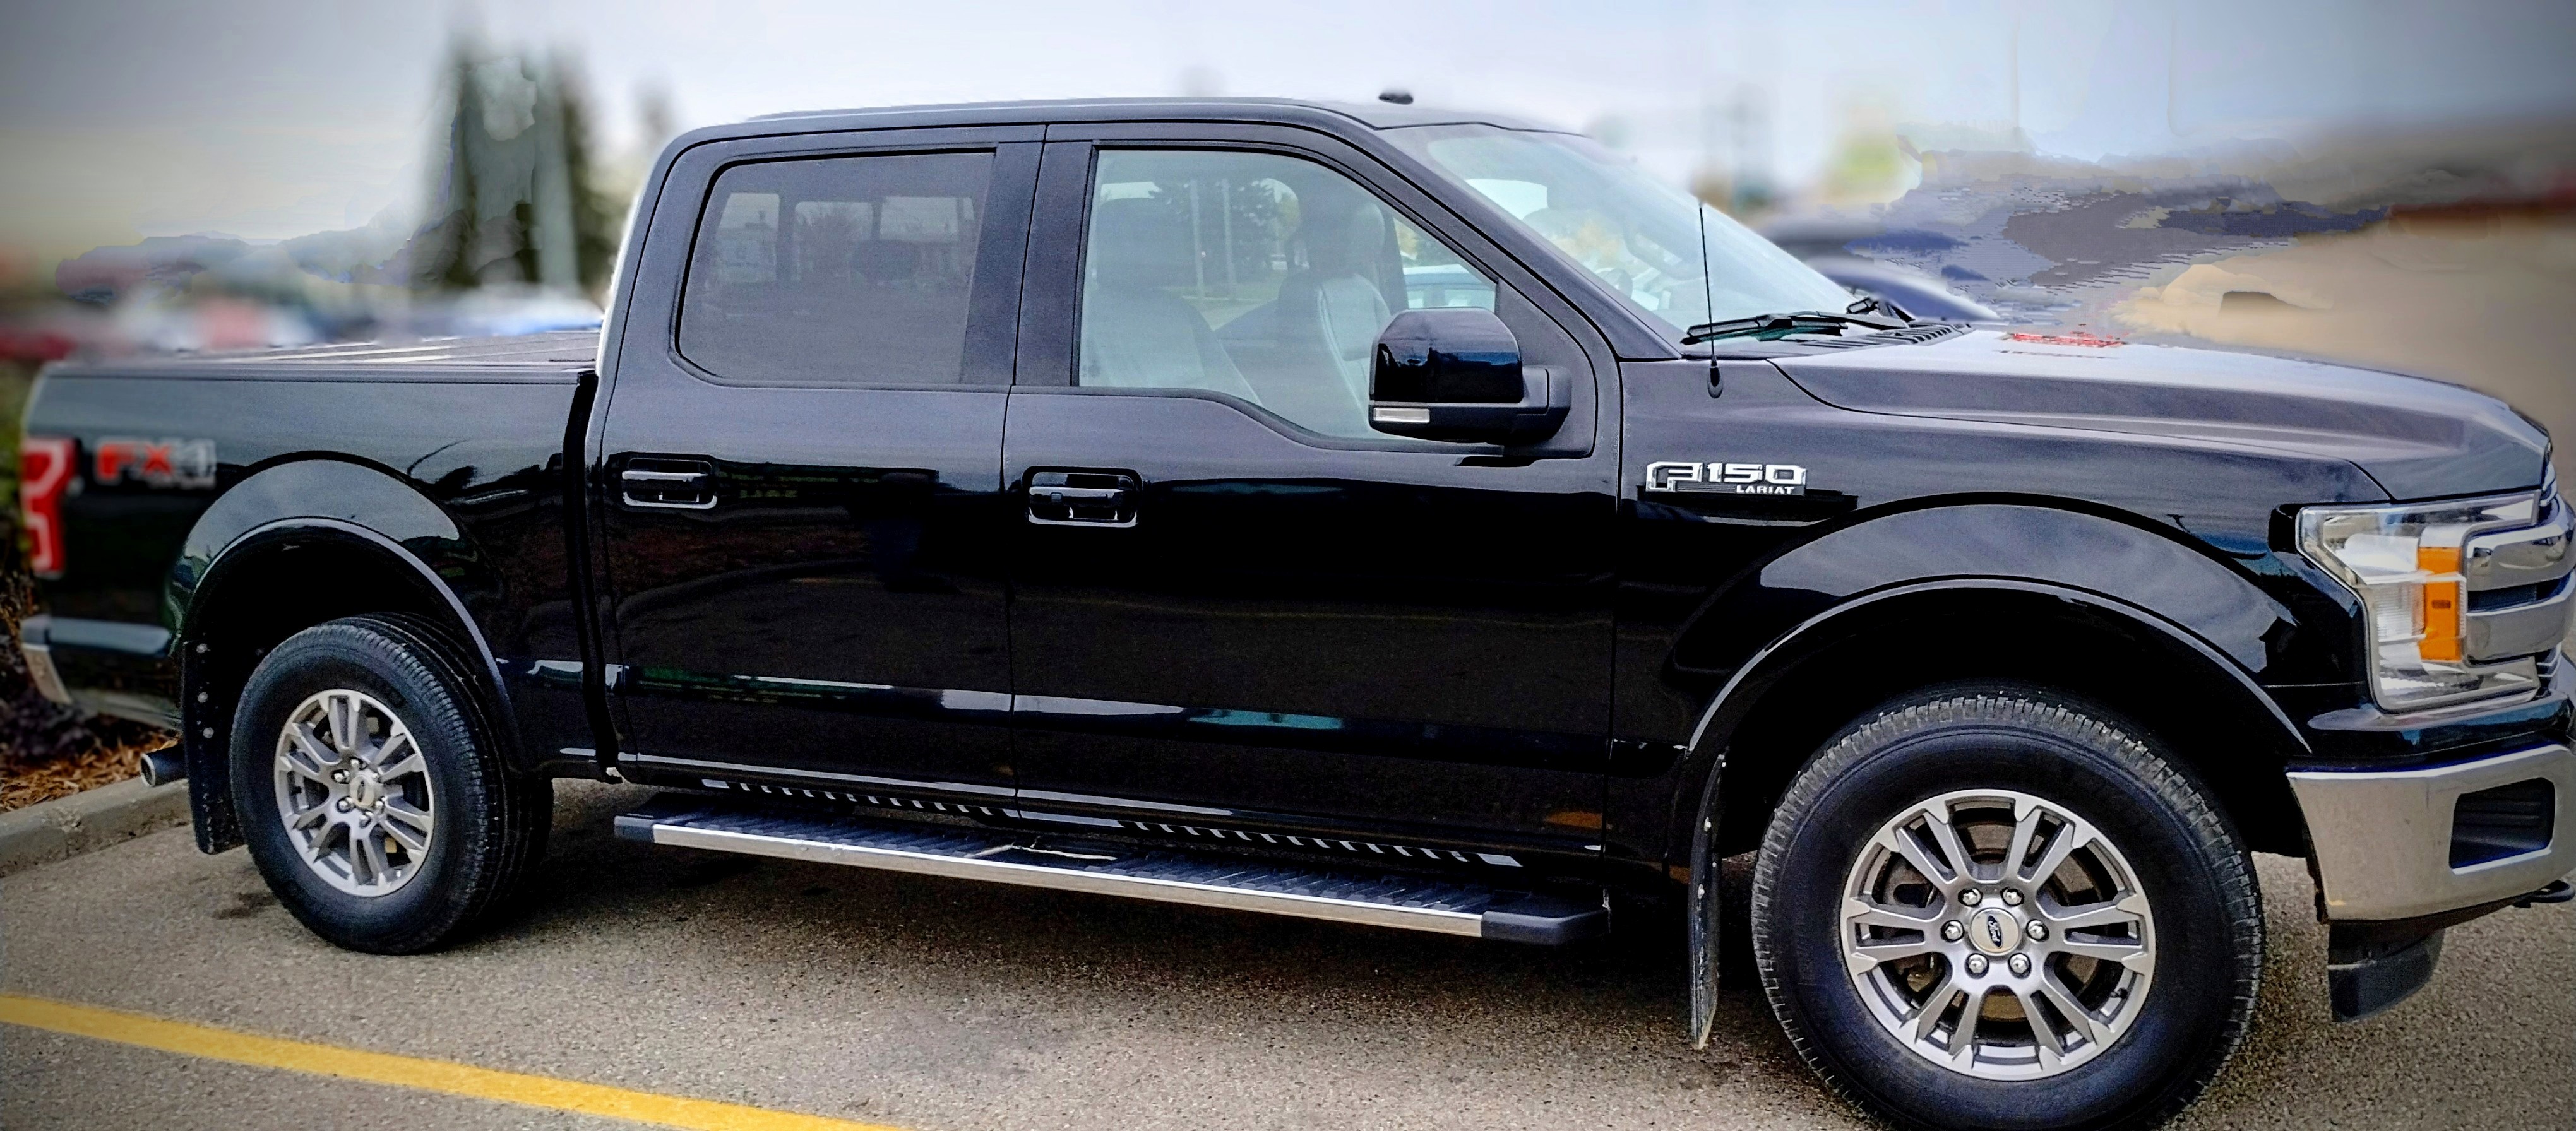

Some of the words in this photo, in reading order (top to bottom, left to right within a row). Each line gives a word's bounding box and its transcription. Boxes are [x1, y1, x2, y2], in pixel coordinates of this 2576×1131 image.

[95, 438, 217, 485] FX4
[1736, 485, 1795, 495] LARIAT
[1988, 920, 2001, 942] Ford
